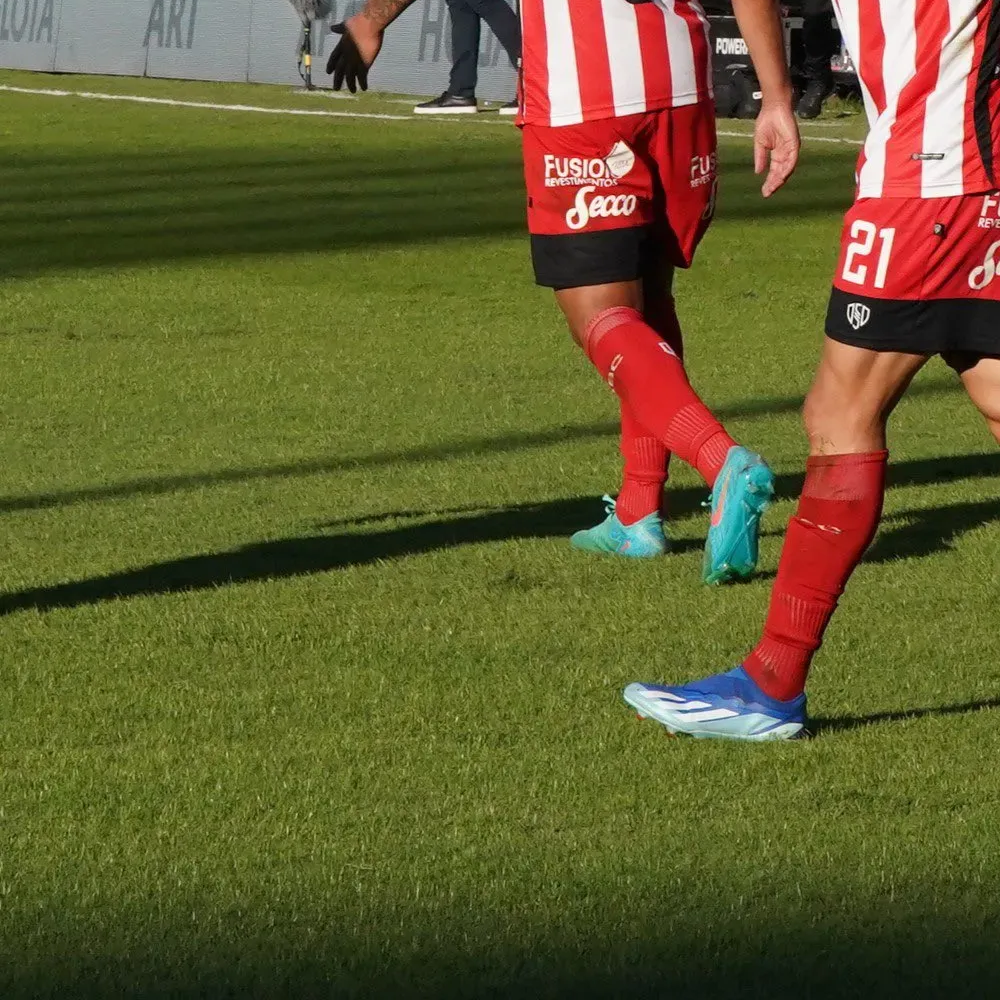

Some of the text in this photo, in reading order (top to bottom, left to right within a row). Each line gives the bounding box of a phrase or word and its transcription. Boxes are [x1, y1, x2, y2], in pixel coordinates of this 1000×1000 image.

[716, 38, 748, 55] POWER
[565, 186, 638, 230] Secco
[842, 220, 896, 289] 21
